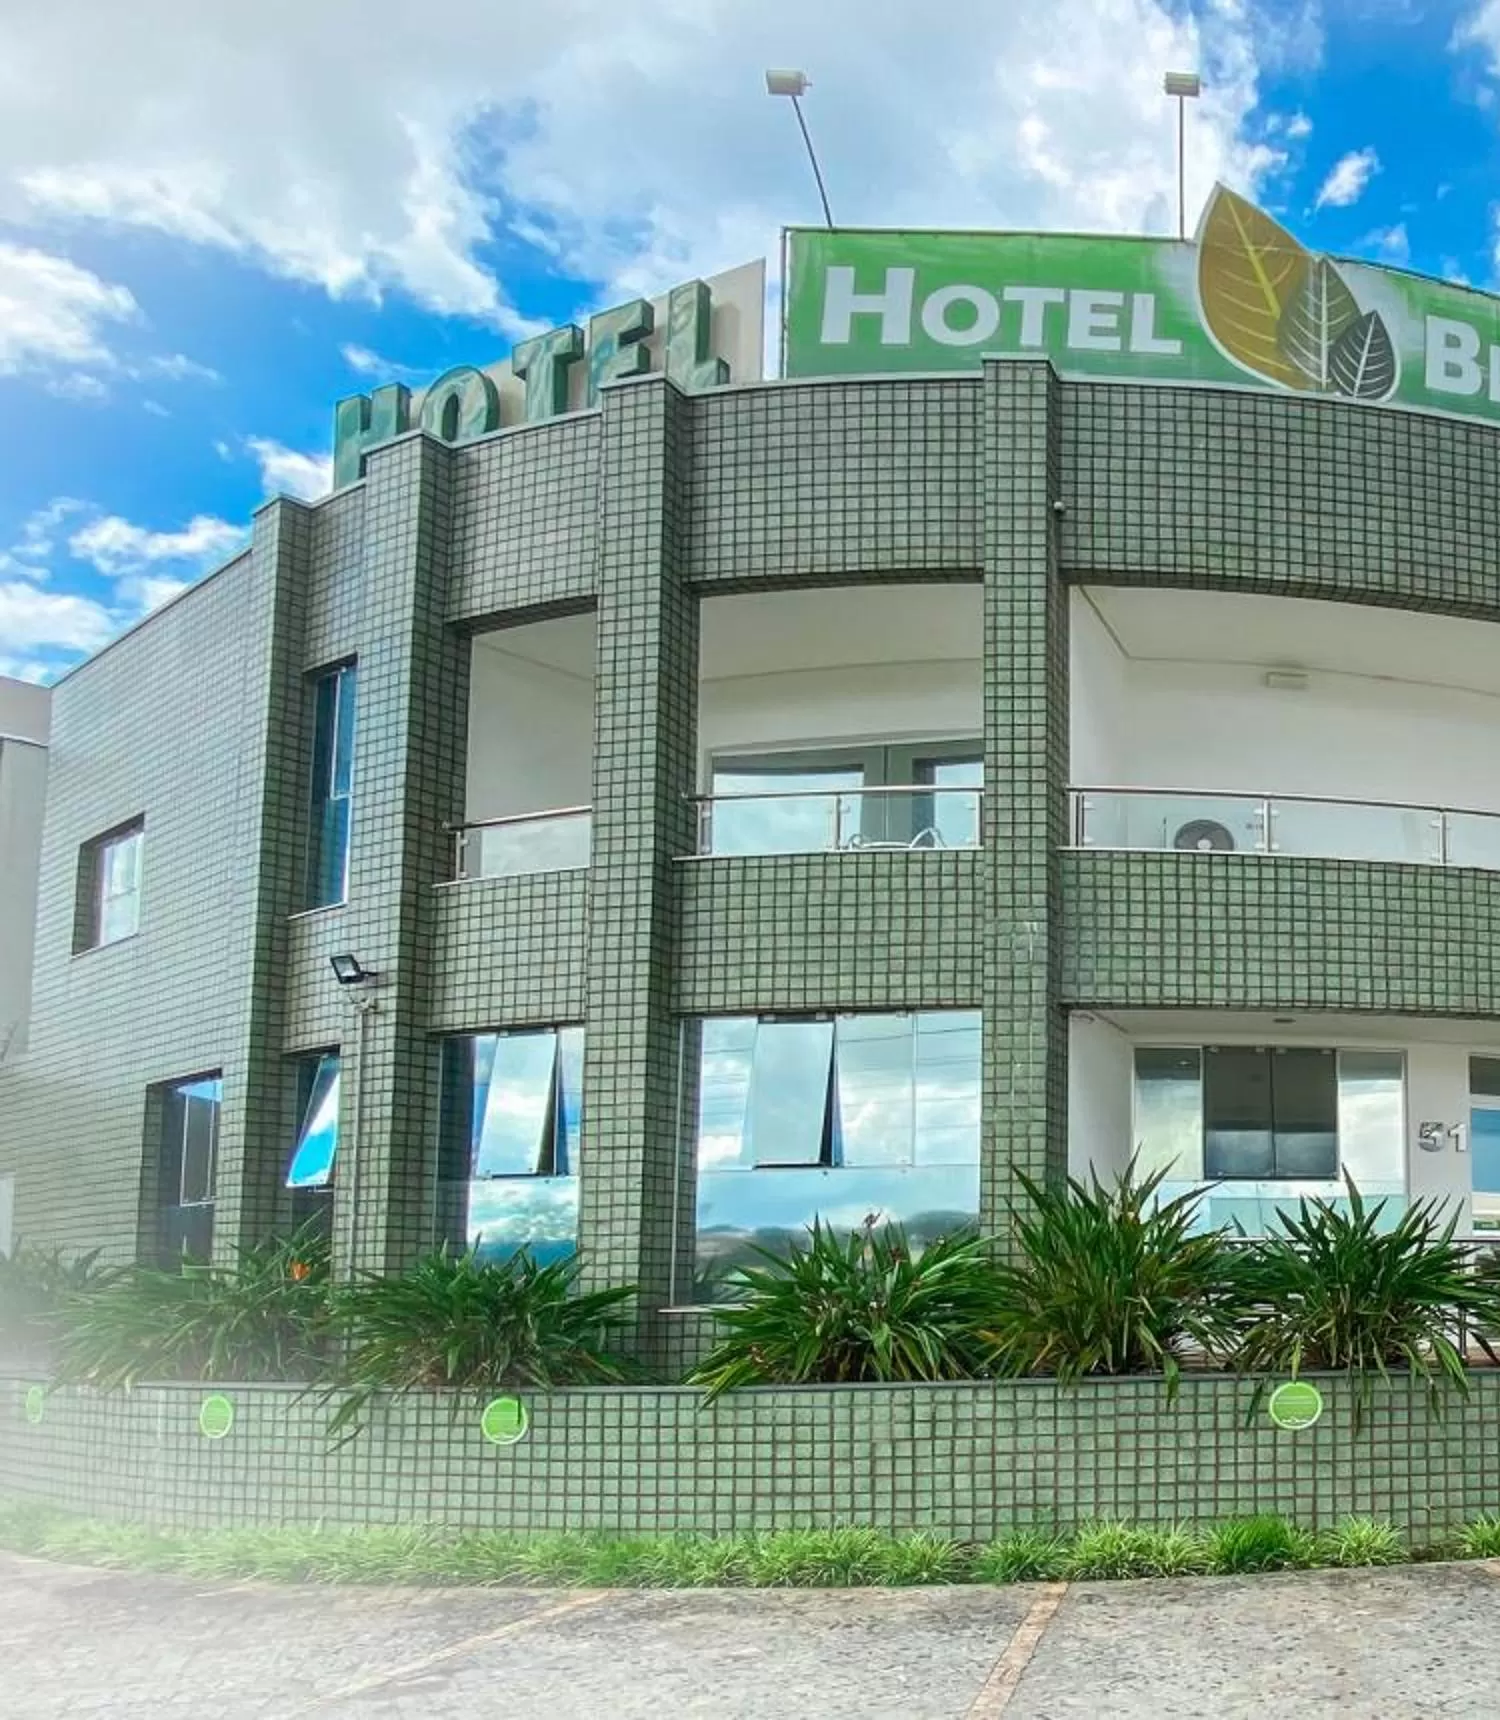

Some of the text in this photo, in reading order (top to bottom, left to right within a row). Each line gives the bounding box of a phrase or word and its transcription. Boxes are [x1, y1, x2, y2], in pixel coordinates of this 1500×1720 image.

[819, 265, 1184, 356] HOTEL
[334, 280, 731, 490] HOTEL
[1418, 1121, 1470, 1153] 51
